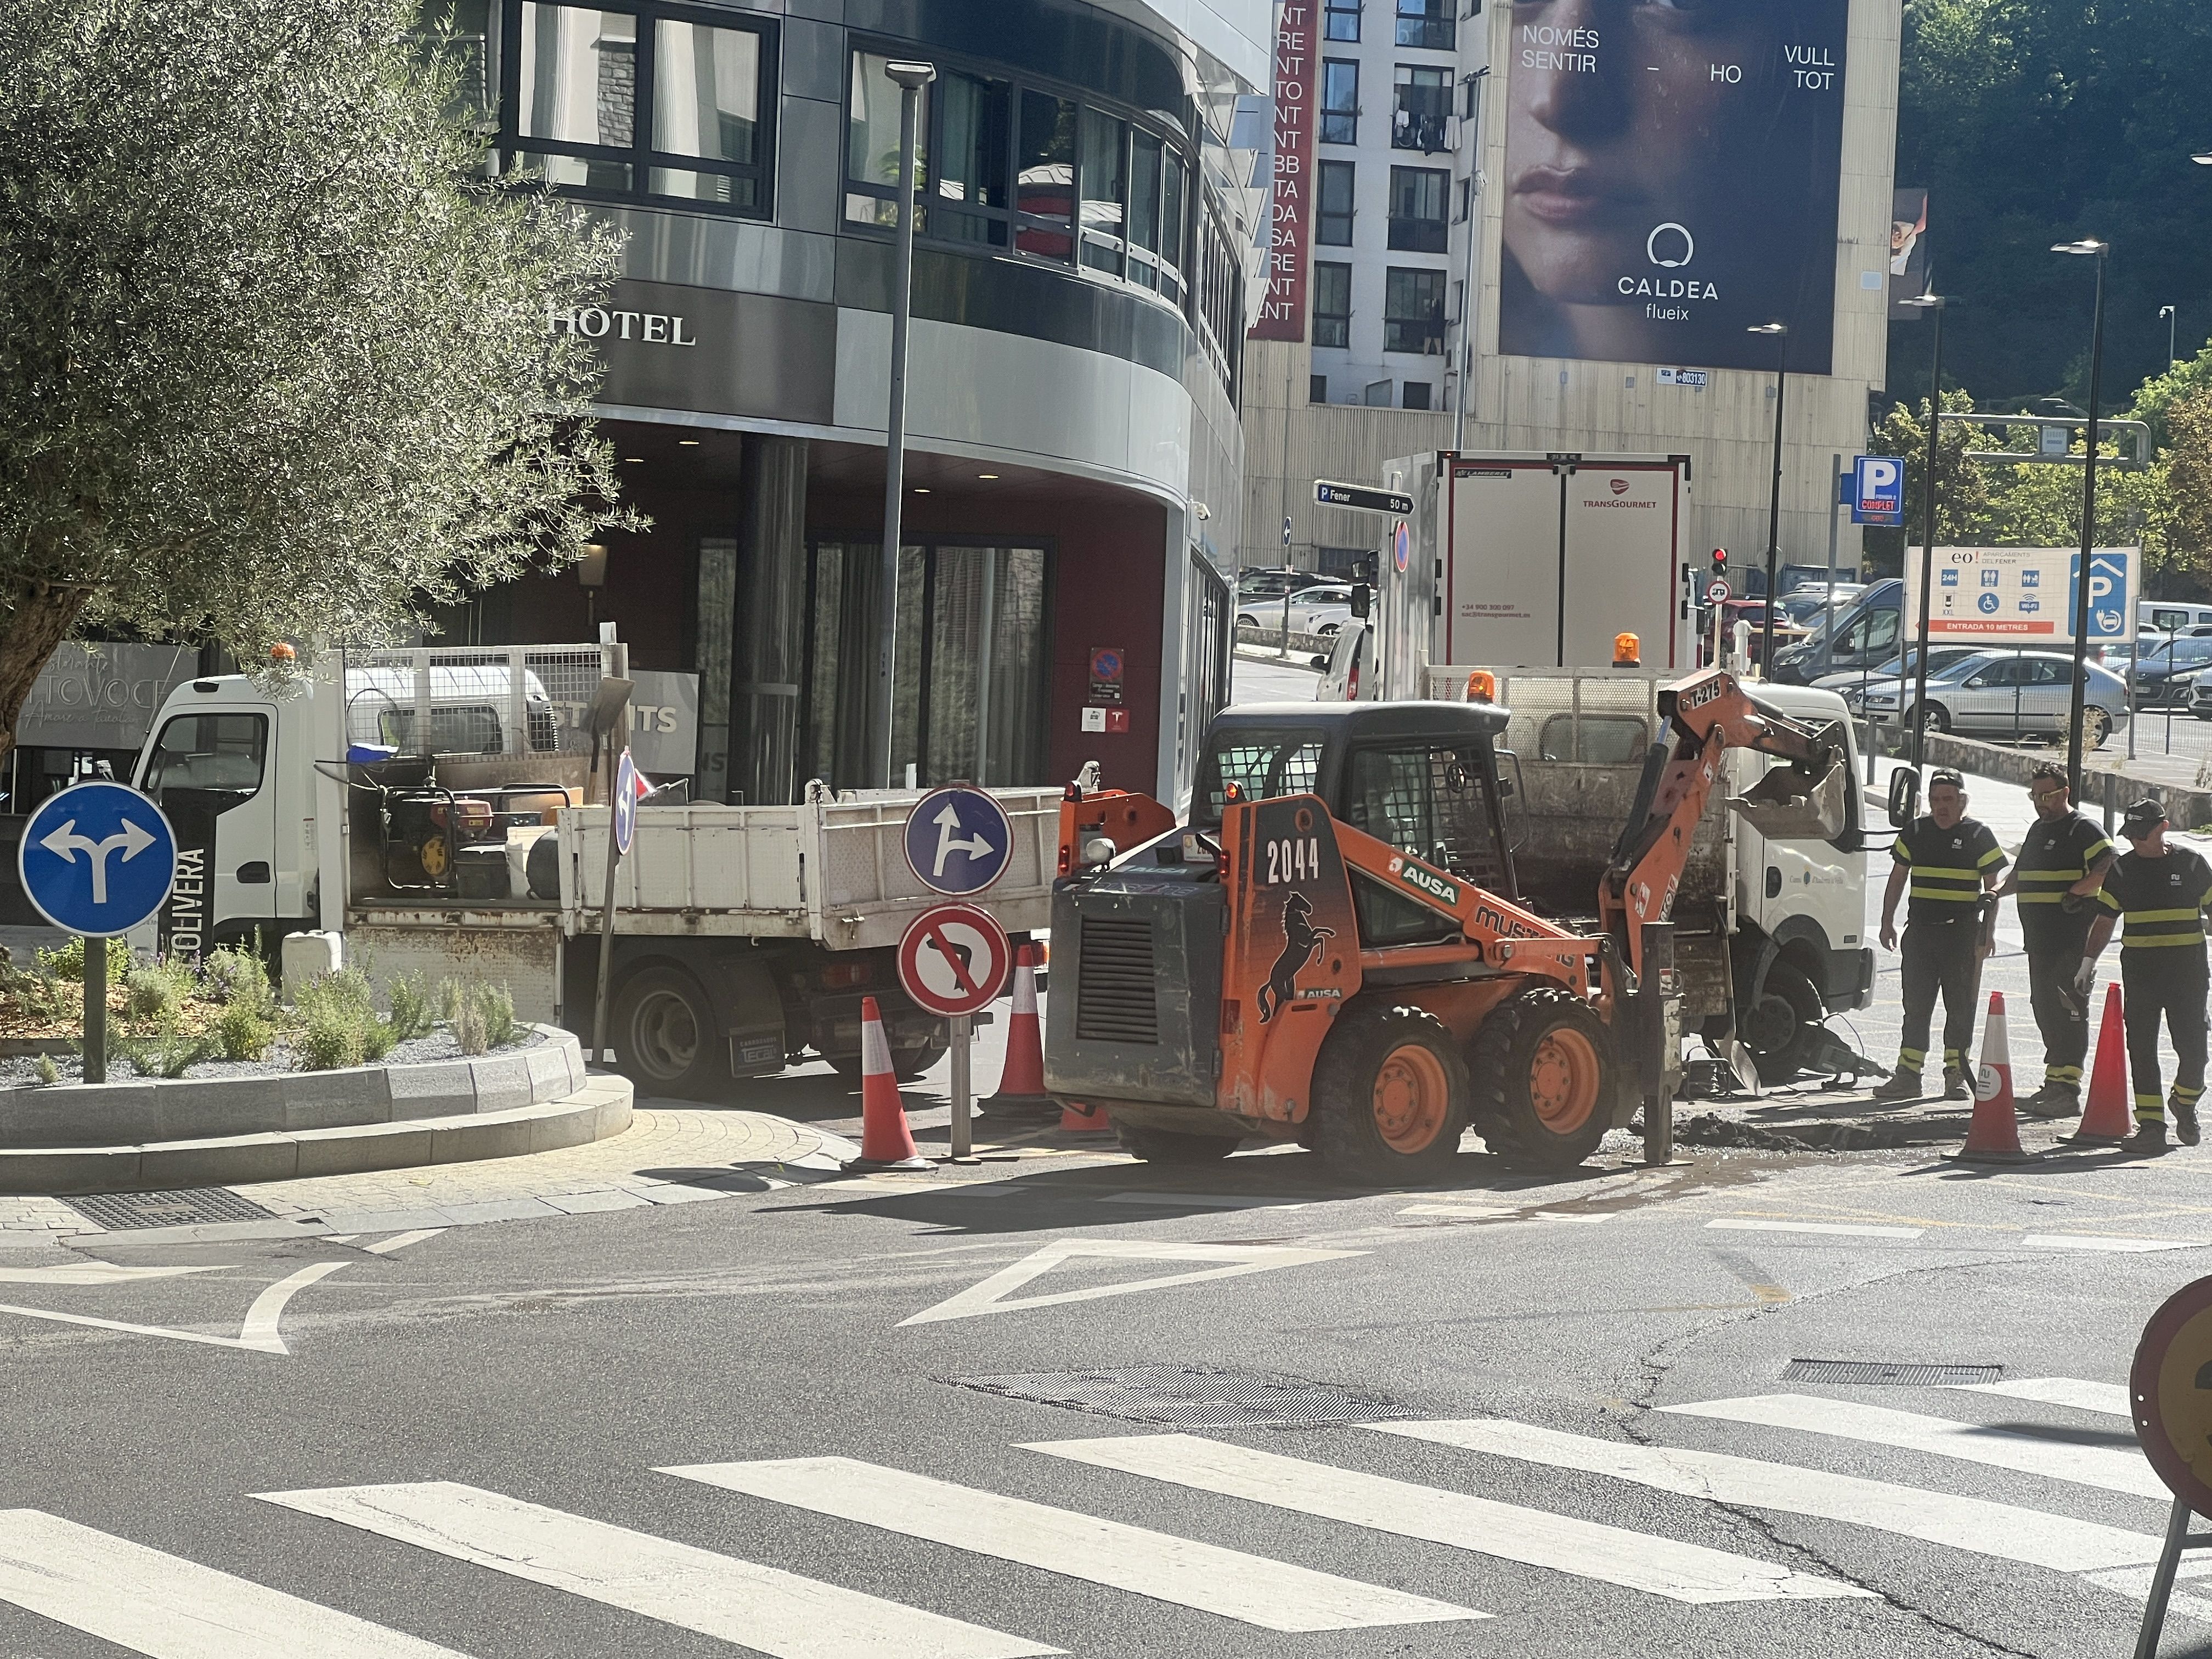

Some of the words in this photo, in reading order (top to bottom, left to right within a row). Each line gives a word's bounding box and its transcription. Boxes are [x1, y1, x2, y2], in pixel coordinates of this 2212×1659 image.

[1277, 31, 1305, 50] RE
[1523, 25, 1599, 48] NOMÉS
[1521, 49, 1596, 73] SENTIR
[1784, 44, 1835, 66] VULL
[1711, 64, 1742, 83] HO
[1793, 70, 1835, 90] TOT
[1276, 81, 1302, 100] TO
[1274, 105, 1302, 124] NT
[1274, 179, 1298, 198] TA
[1618, 276, 1718, 300] CALDEA
[1646, 303, 1689, 320] flueix
[546, 307, 696, 346] HOTEL
[1863, 460, 1897, 500] P
[1322, 487, 1328, 499] P
[1330, 489, 1351, 502] Fener
[1390, 499, 1400, 509] 50
[1402, 503, 1408, 511] m
[1583, 499, 1657, 508] TRANSGOURMET
[2087, 576, 2112, 608] P
[1691, 680, 1720, 707] T-275
[1267, 838, 1319, 884] 2044
[1403, 866, 1456, 904] AUSA
[1307, 989, 1341, 998] AUSA
